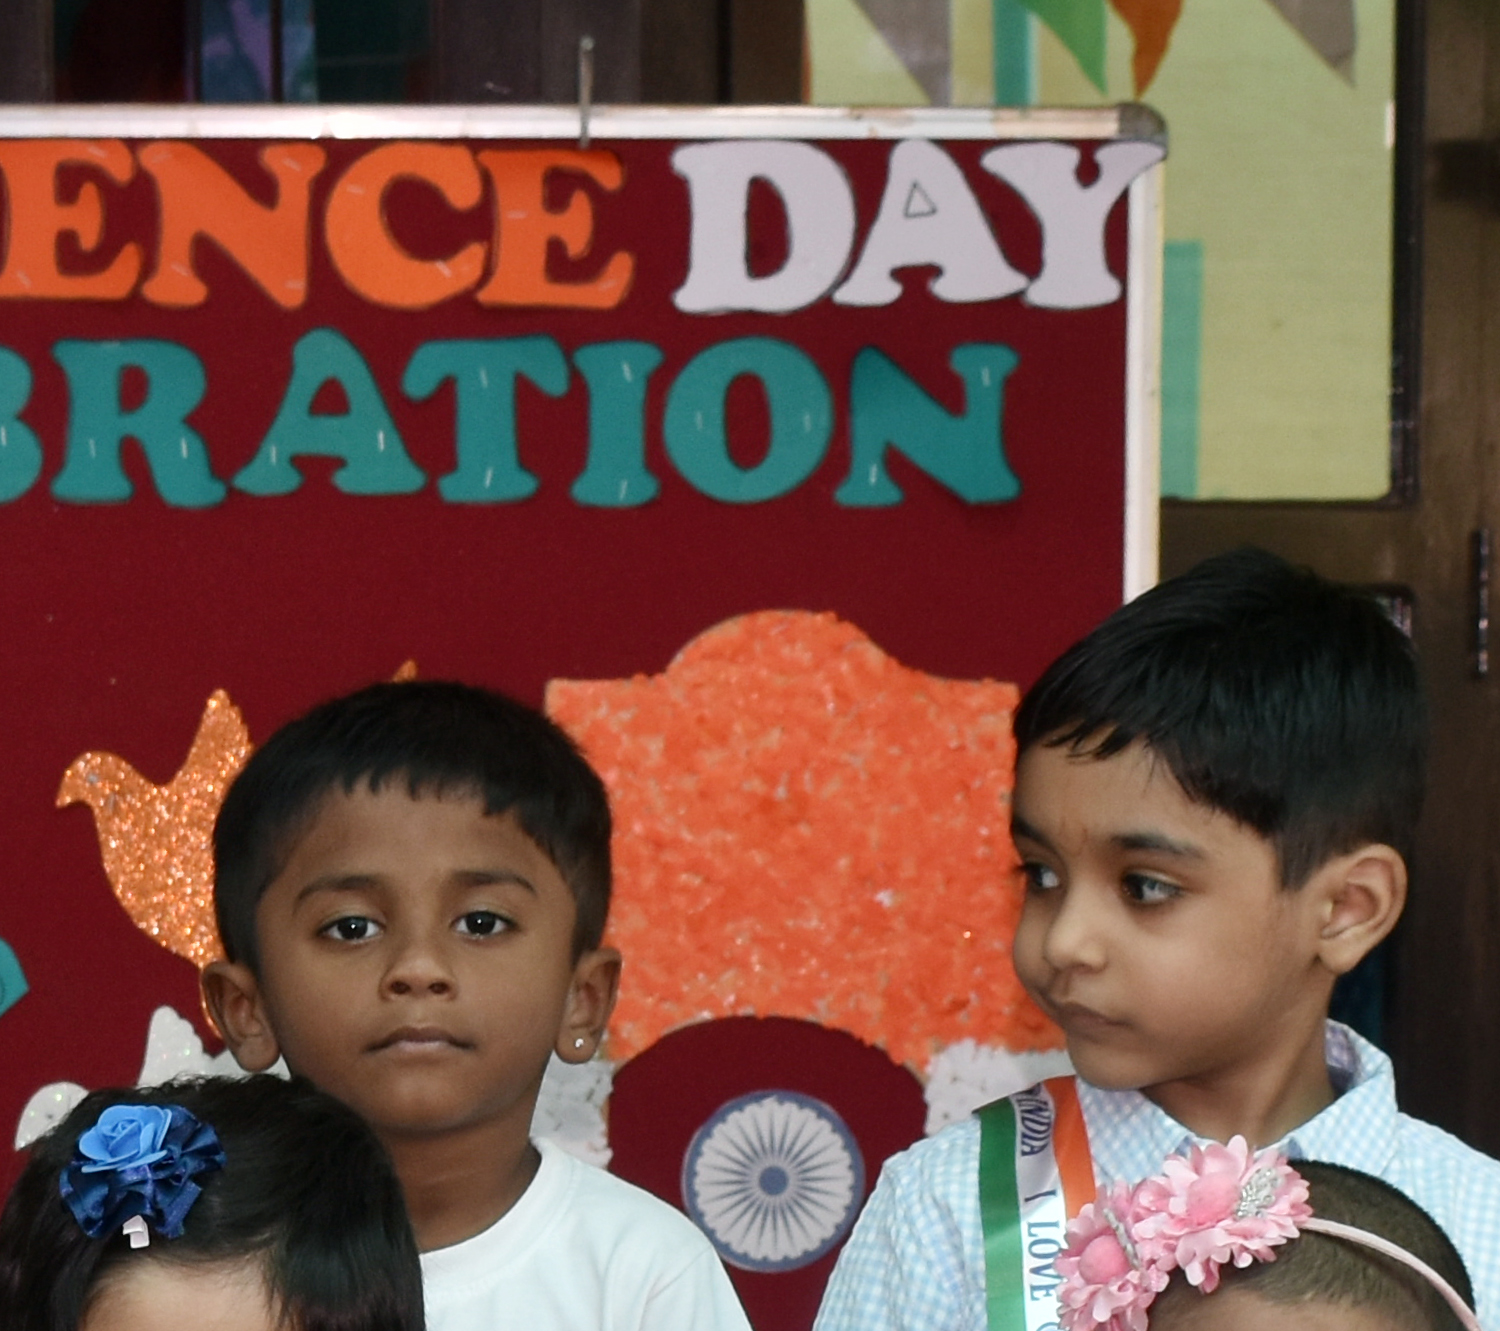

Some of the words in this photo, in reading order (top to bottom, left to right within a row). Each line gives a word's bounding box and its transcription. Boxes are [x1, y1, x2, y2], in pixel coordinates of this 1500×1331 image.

[671, 138, 1168, 314] DAY
[1025, 1189, 1057, 1203] I
[1027, 1221, 1066, 1301] LOVE
